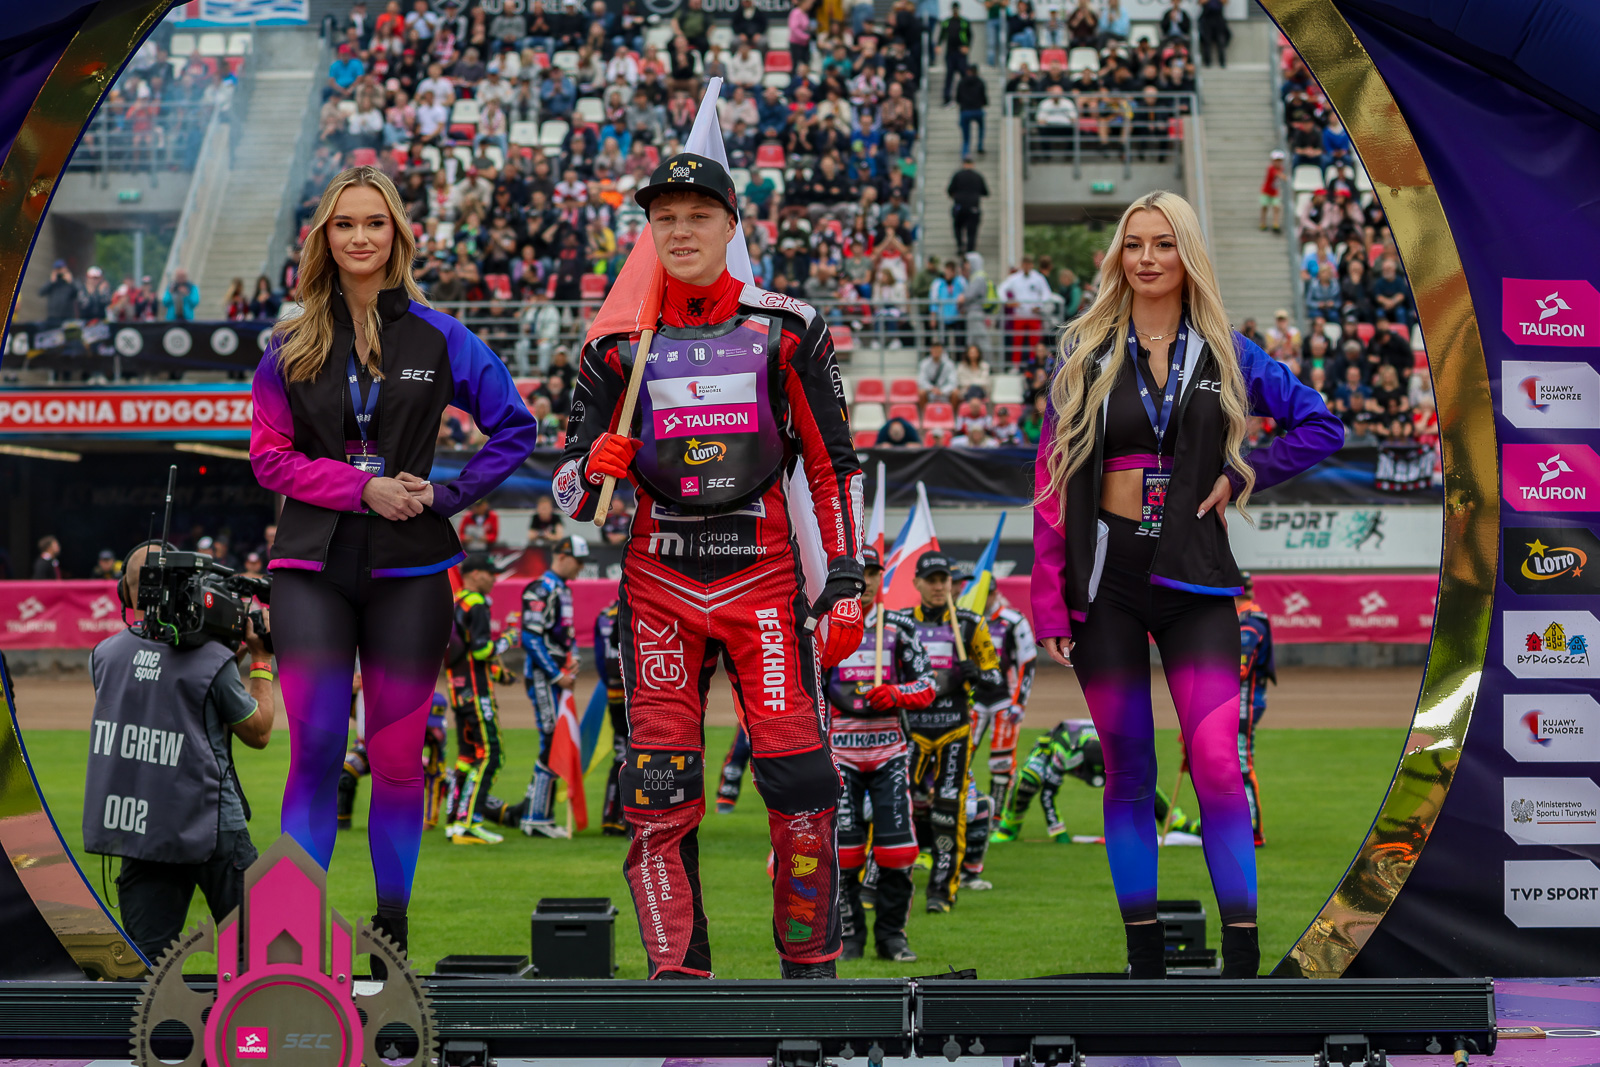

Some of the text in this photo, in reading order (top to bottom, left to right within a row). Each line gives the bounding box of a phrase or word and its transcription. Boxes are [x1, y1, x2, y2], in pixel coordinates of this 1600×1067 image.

[1519, 322, 1585, 337] TAURON
[694, 348, 706, 361] 18
[400, 369, 435, 382] SEC
[1540, 385, 1574, 393] KUJAWY
[0, 400, 115, 424] POLONIA
[683, 412, 748, 428] TAURON
[692, 445, 719, 461] LOTTO
[706, 477, 735, 489] SEC
[1519, 486, 1586, 500] TAURON
[830, 496, 845, 552] KW PRODUCTS
[1258, 511, 1340, 530] SPORT
[699, 531, 738, 544] Grupa
[1135, 526, 1161, 538] SE
[1285, 531, 1334, 549] LAB
[699, 544, 767, 557] Moderator
[1534, 553, 1575, 574] LOTTO
[133, 650, 161, 668] one
[755, 607, 786, 711] BECKHOFF
[1517, 654, 1586, 665] BYDGOSZCZ
[134, 666, 161, 682] sport
[921, 713, 961, 722] SYSTEM
[1542, 719, 1576, 727] KUJAWY
[93, 719, 184, 767] TV CREW
[832, 732, 898, 747] WIKARO
[643, 769, 674, 780] NOVA
[643, 780, 675, 790] CODE
[103, 794, 149, 835] 002
[1536, 809, 1560, 818] Sportu
[1565, 809, 1597, 818] Turystyki
[651, 855, 673, 901] Pakość
[1510, 887, 1599, 901] TVP SPORT
[282, 1033, 332, 1049] SEC
